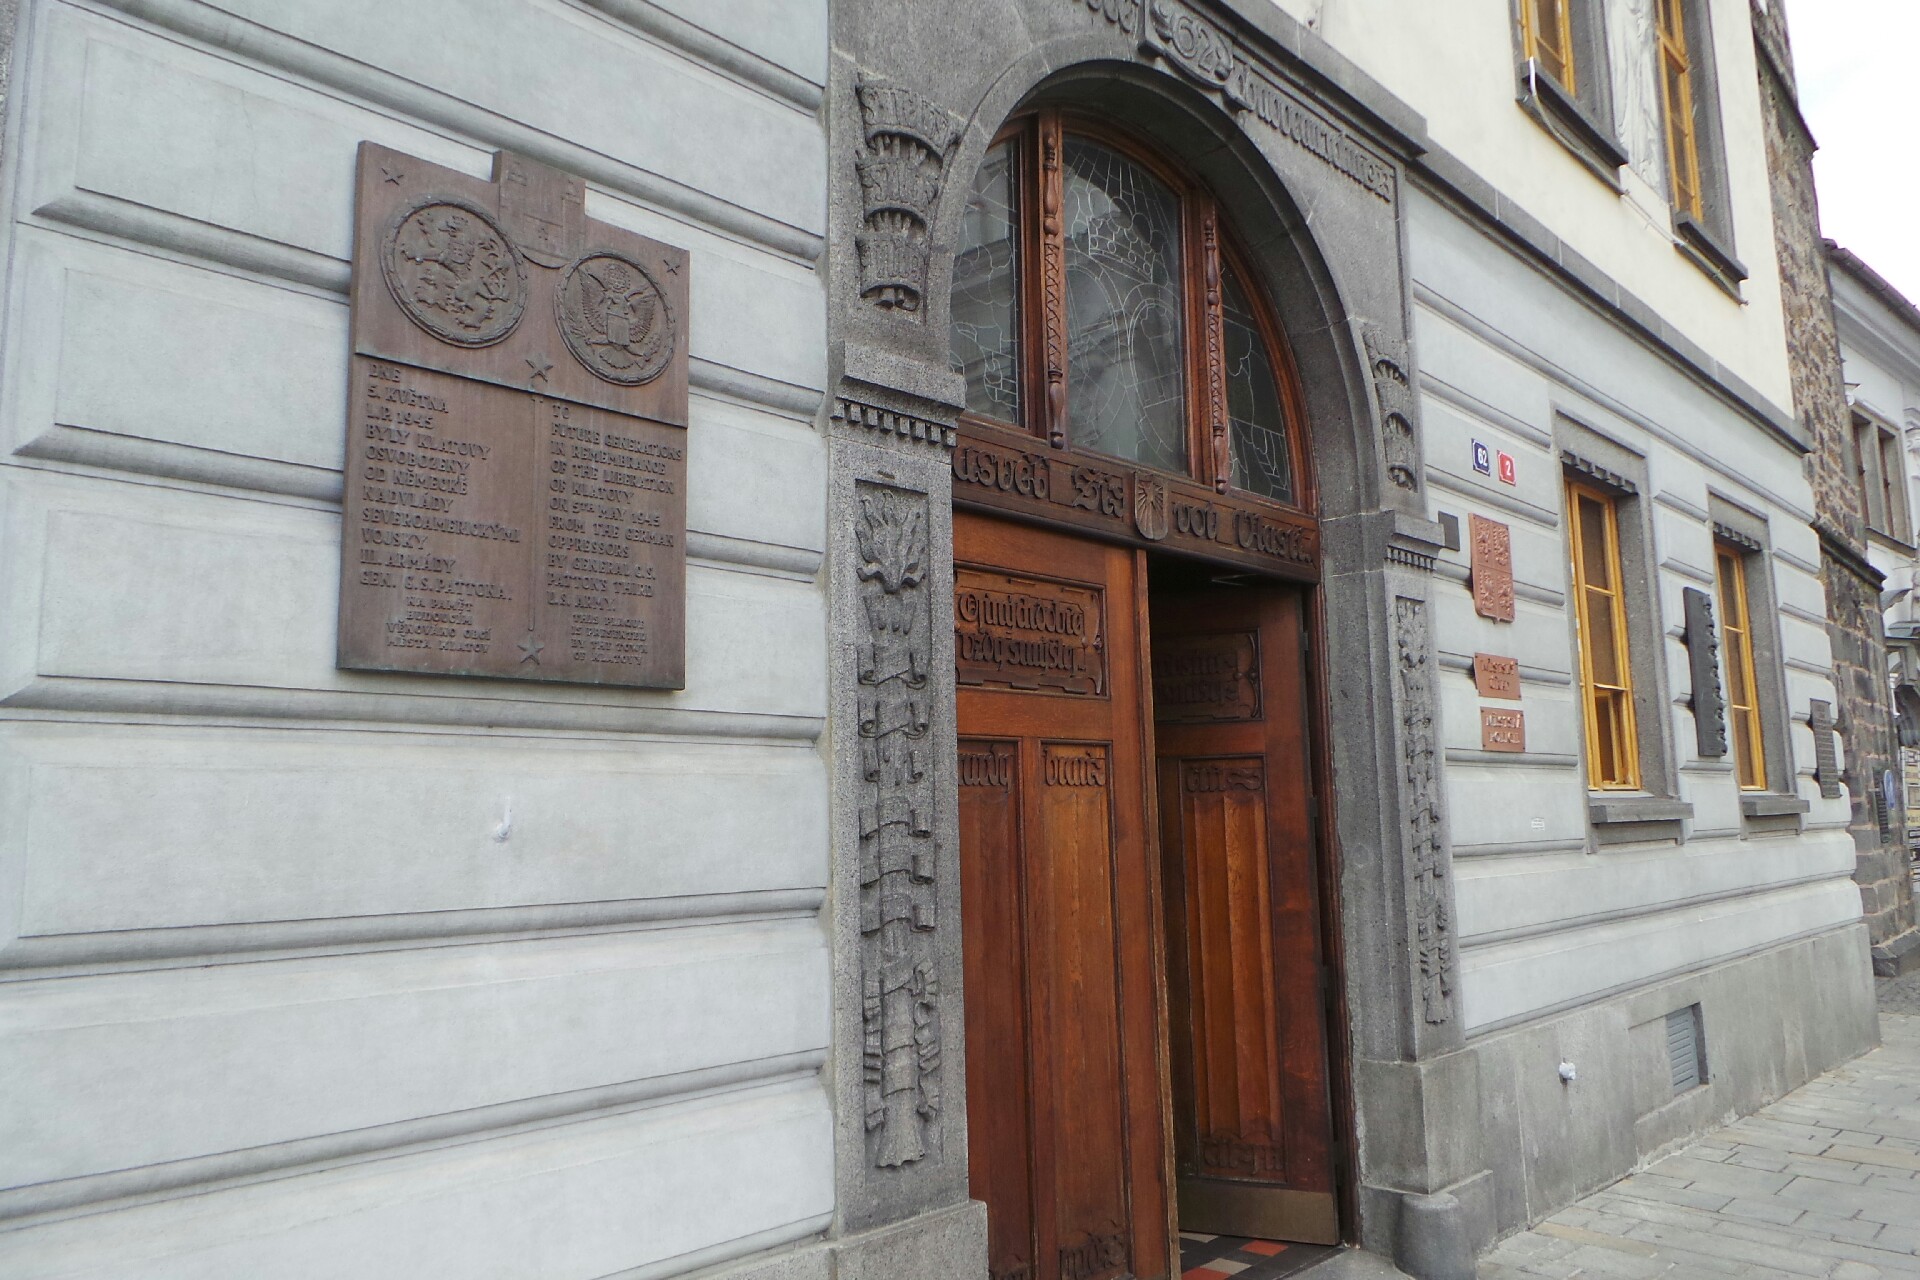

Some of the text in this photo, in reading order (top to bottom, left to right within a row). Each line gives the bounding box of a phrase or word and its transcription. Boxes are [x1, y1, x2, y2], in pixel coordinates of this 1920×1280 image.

[369, 364, 400, 383] DNE
[386, 388, 448, 414] KVĚTNA
[398, 412, 434, 429] 1945
[552, 405, 570, 419] TO
[366, 423, 491, 460] BYLY KLATOVY
[551, 423, 682, 461] FUTURE GENERATIONS
[365, 446, 470, 475] OSVOBOZENY
[550, 440, 666, 475] IN REMEMBRANCE
[1478, 448, 1489, 466] 62
[364, 467, 386, 482] OD
[551, 460, 674, 495] OF THE LIBERATION
[1505, 461, 1512, 476] 2
[363, 485, 453, 513] NADVLÁDY
[550, 479, 635, 505] OF KLATOVY
[550, 498, 568, 513] ON
[598, 507, 626, 521] MAY
[632, 512, 660, 527] 1945
[362, 508, 521, 543] SEVEROAMERICKÝMI
[549, 515, 674, 548] FROM THE GERMAN
[361, 528, 428, 550] VOJSKY
[548, 535, 630, 559] OPPRESSORS
[385, 553, 456, 574] ARMÁDY
[548, 553, 567, 569] BY
[573, 557, 631, 577] GENERAL
[360, 571, 396, 588] GEN.
[613, 581, 653, 597] THIRD
[406, 597, 426, 608] NA
[386, 620, 456, 638] VĚNOVÁNO
[572, 614, 644, 630] THIS PLAQUE
[571, 626, 647, 641] IS PRESENTED
[387, 634, 490, 654] MĚSTA KLATOV
[571, 639, 648, 654] BY THE TOWN
[574, 652, 641, 666] OF KLATOVY
